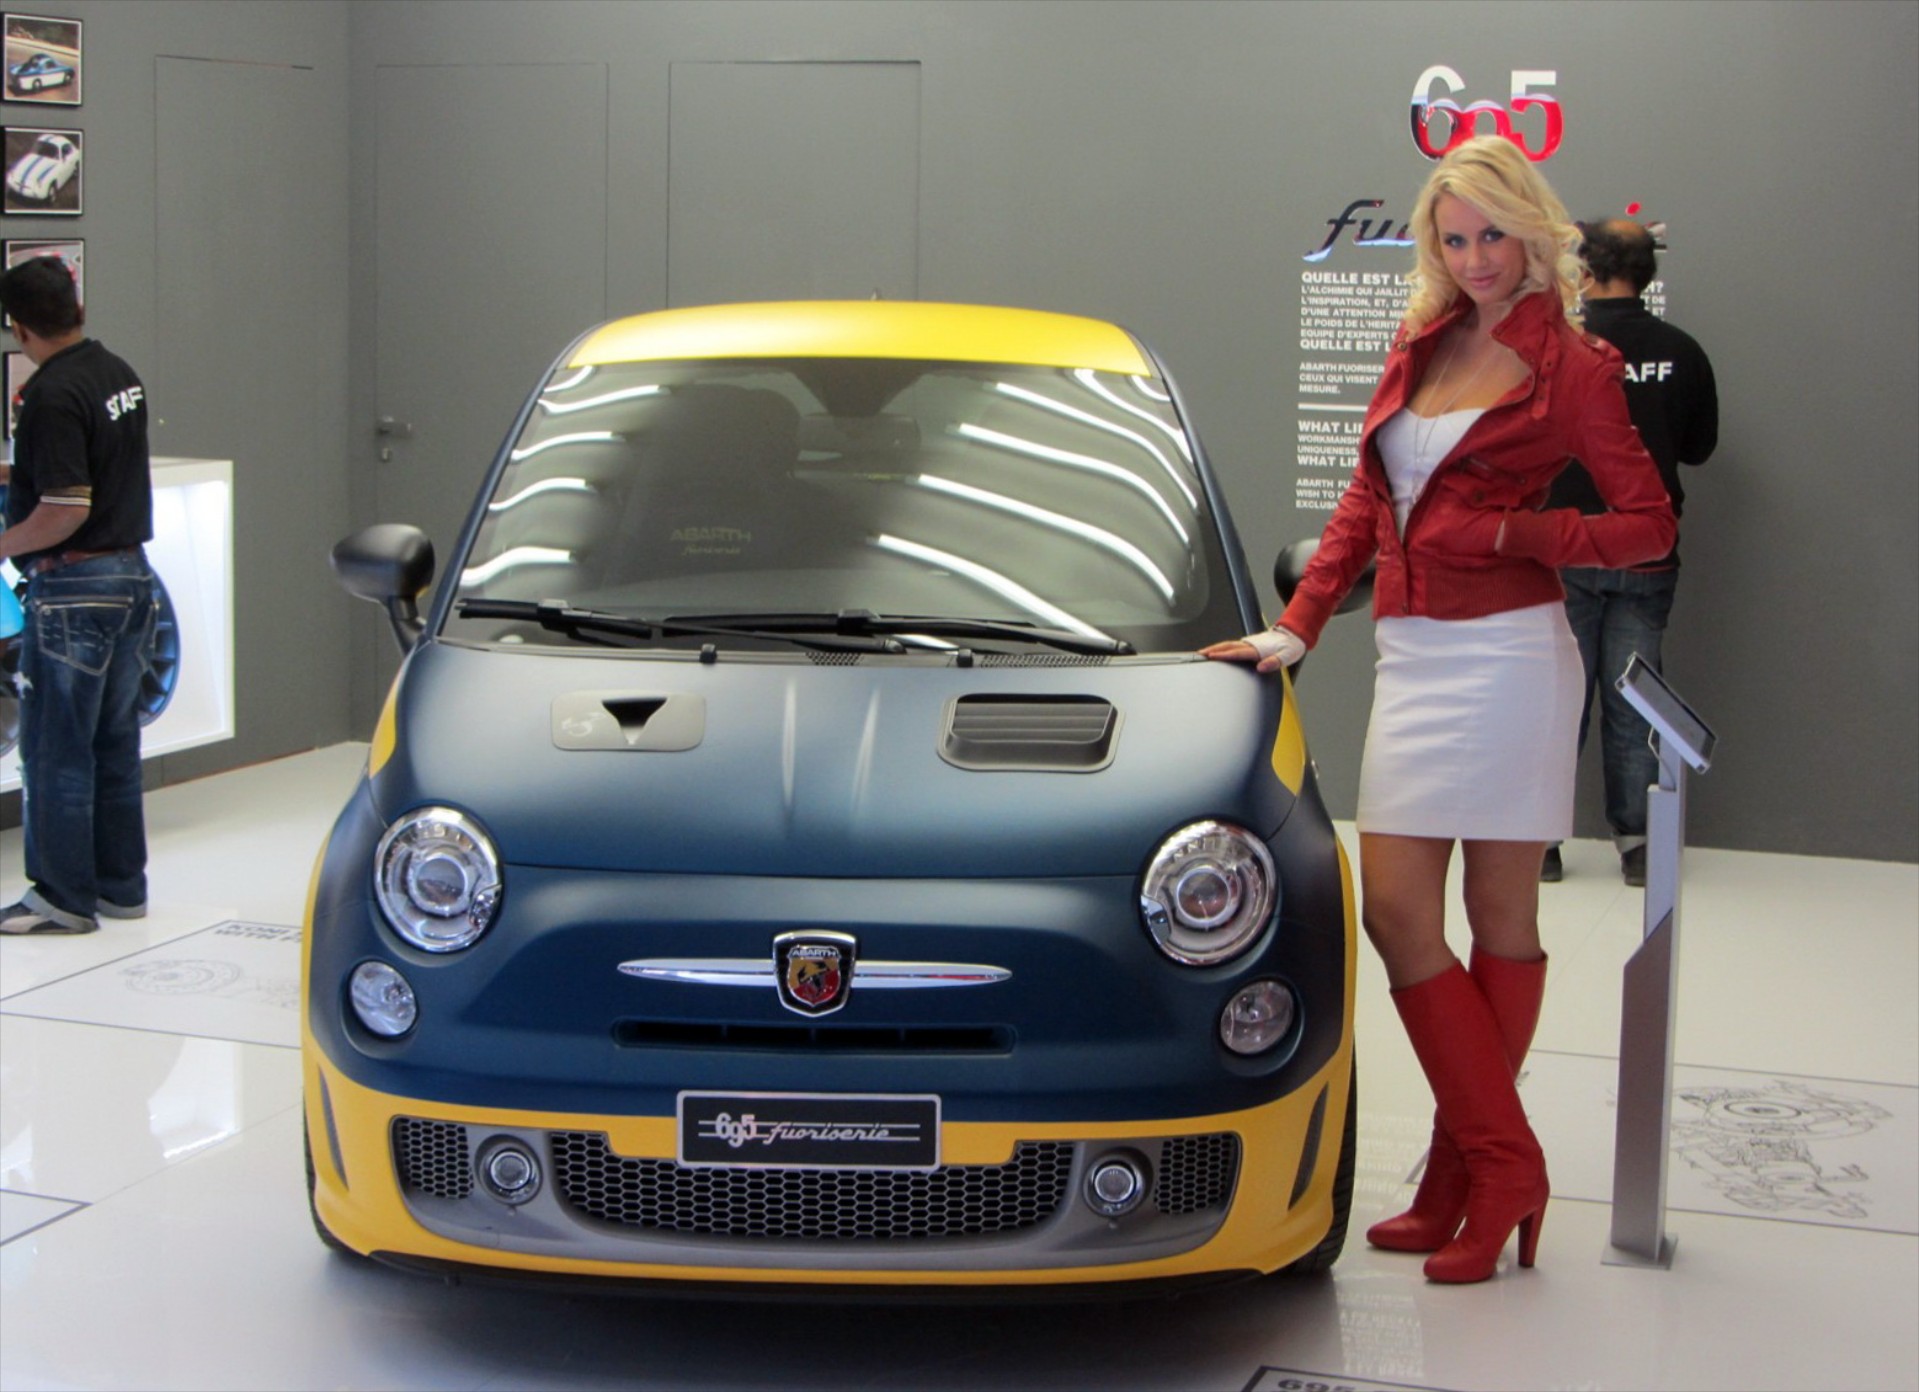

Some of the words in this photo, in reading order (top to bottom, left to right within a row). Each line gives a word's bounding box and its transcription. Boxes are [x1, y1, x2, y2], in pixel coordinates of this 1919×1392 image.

[1301, 272, 1358, 285] QUELLE
[1363, 273, 1390, 285] EST
[1356, 287, 1372, 297] QUI
[1333, 308, 1386, 318] ATTENTION
[1301, 317, 1312, 327] LE
[1315, 318, 1343, 328] POIDS
[1345, 320, 1357, 328] DE
[1300, 328, 1334, 338] EQUIPE
[1337, 330, 1389, 340] D'EXPERTS
[1300, 339, 1352, 351] QUELLE
[1356, 341, 1381, 352] EST
[1299, 362, 1337, 372] ABARTH
[1338, 363, 1385, 373] FUORISER
[1625, 362, 1673, 382] AFF
[1299, 373, 1324, 383] CEUX
[1327, 374, 1343, 384] QUI
[1345, 375, 1378, 384] VISENT
[1298, 420, 1340, 433] WHAT
[1297, 434, 1361, 445] WORKMANSH
[1297, 455, 1336, 467] WHAT
[1296, 478, 1333, 488] ABARTH
[1296, 489, 1320, 499] WISH
[1322, 490, 1335, 499] TO
[792, 949, 836, 957] ABARTH
[715, 1112, 757, 1147] 695
[763, 1122, 889, 1145] fuoriserie
